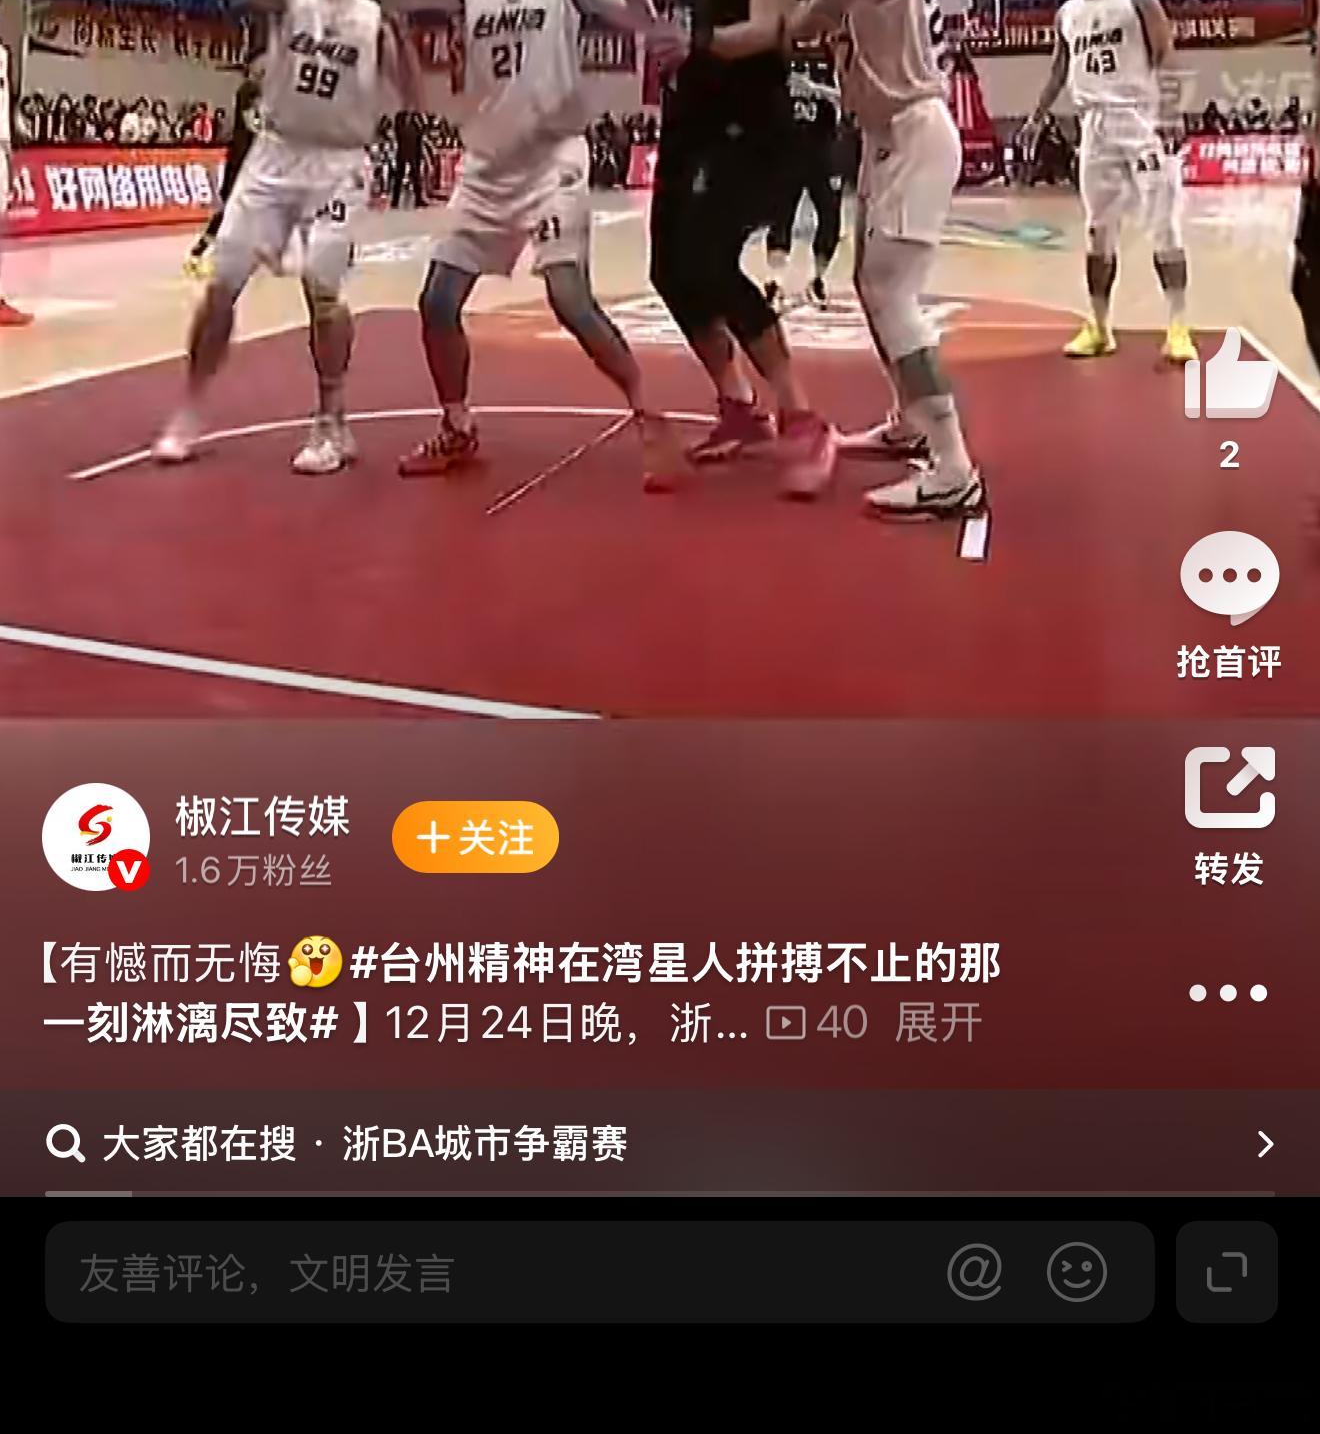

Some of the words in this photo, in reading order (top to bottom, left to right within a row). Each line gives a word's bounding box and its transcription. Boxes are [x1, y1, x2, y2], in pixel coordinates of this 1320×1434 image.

[491, 42, 523, 79] 21
[1085, 49, 1117, 75] 43
[296, 62, 341, 100] 99
